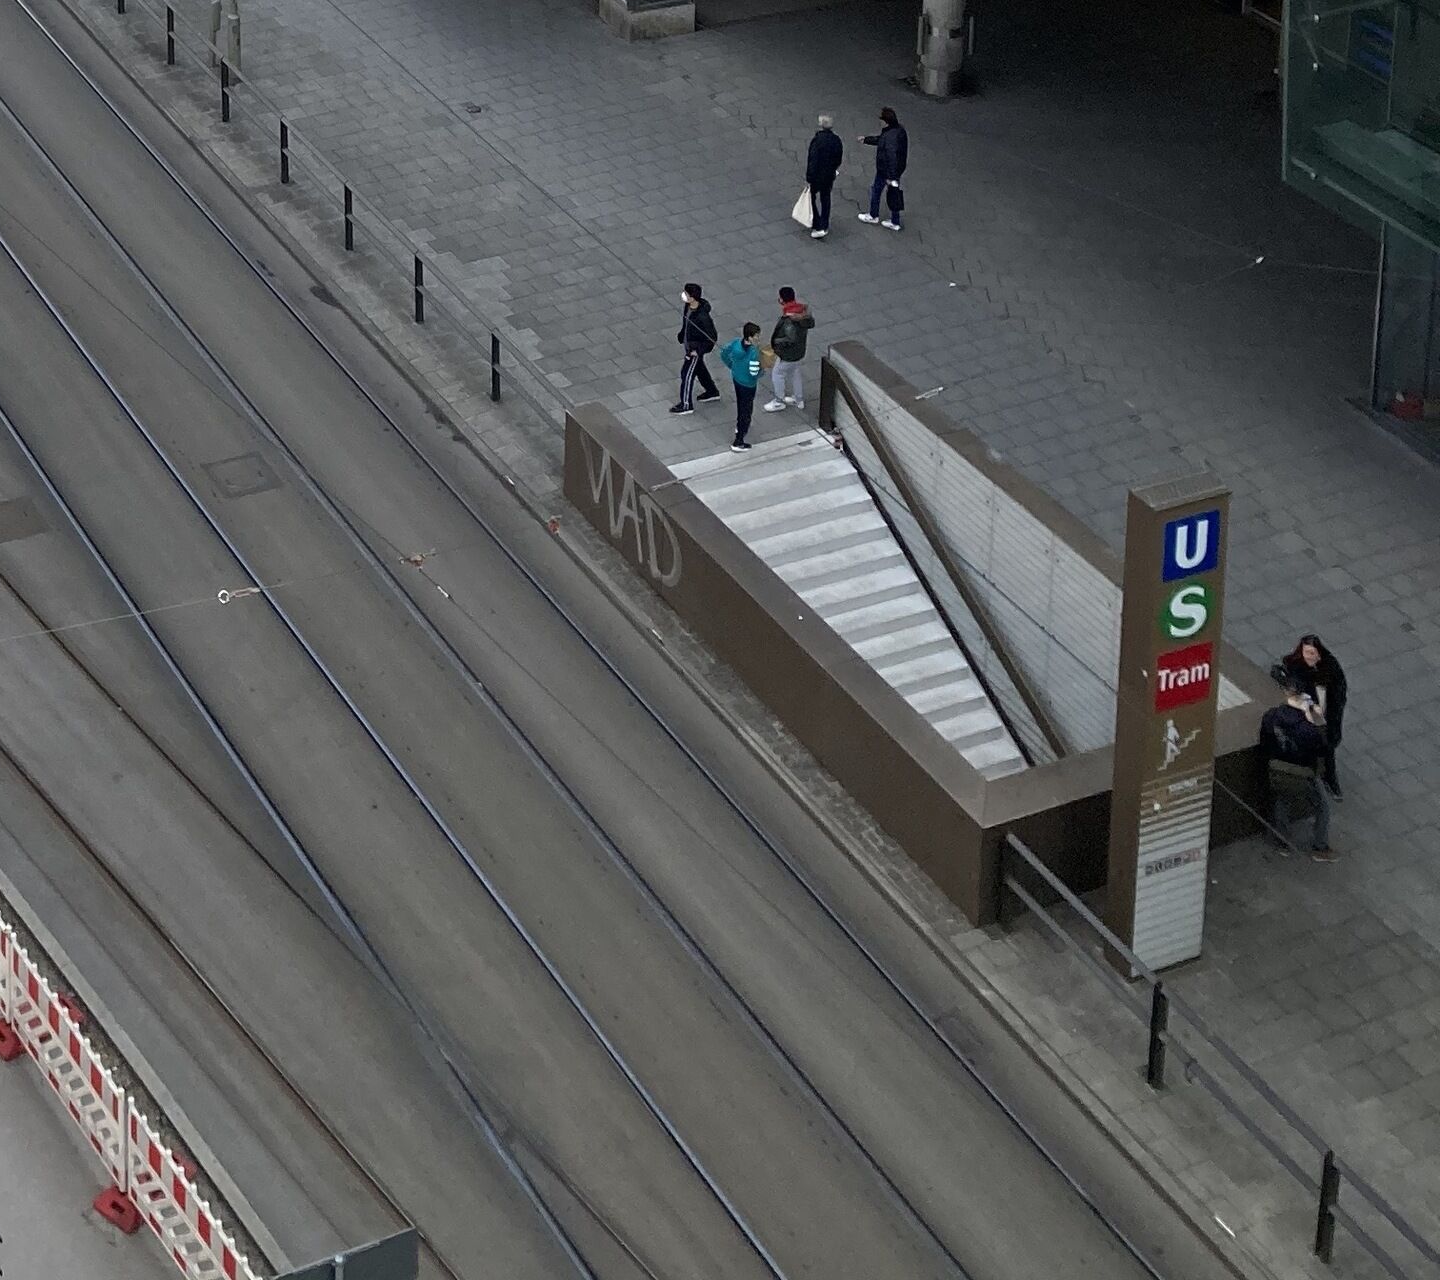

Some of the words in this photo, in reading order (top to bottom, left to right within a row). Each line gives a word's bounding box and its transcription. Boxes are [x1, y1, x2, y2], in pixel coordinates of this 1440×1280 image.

[1174, 519, 1209, 569] U
[1169, 585, 1208, 640] S
[1158, 659, 1210, 692] Tram
